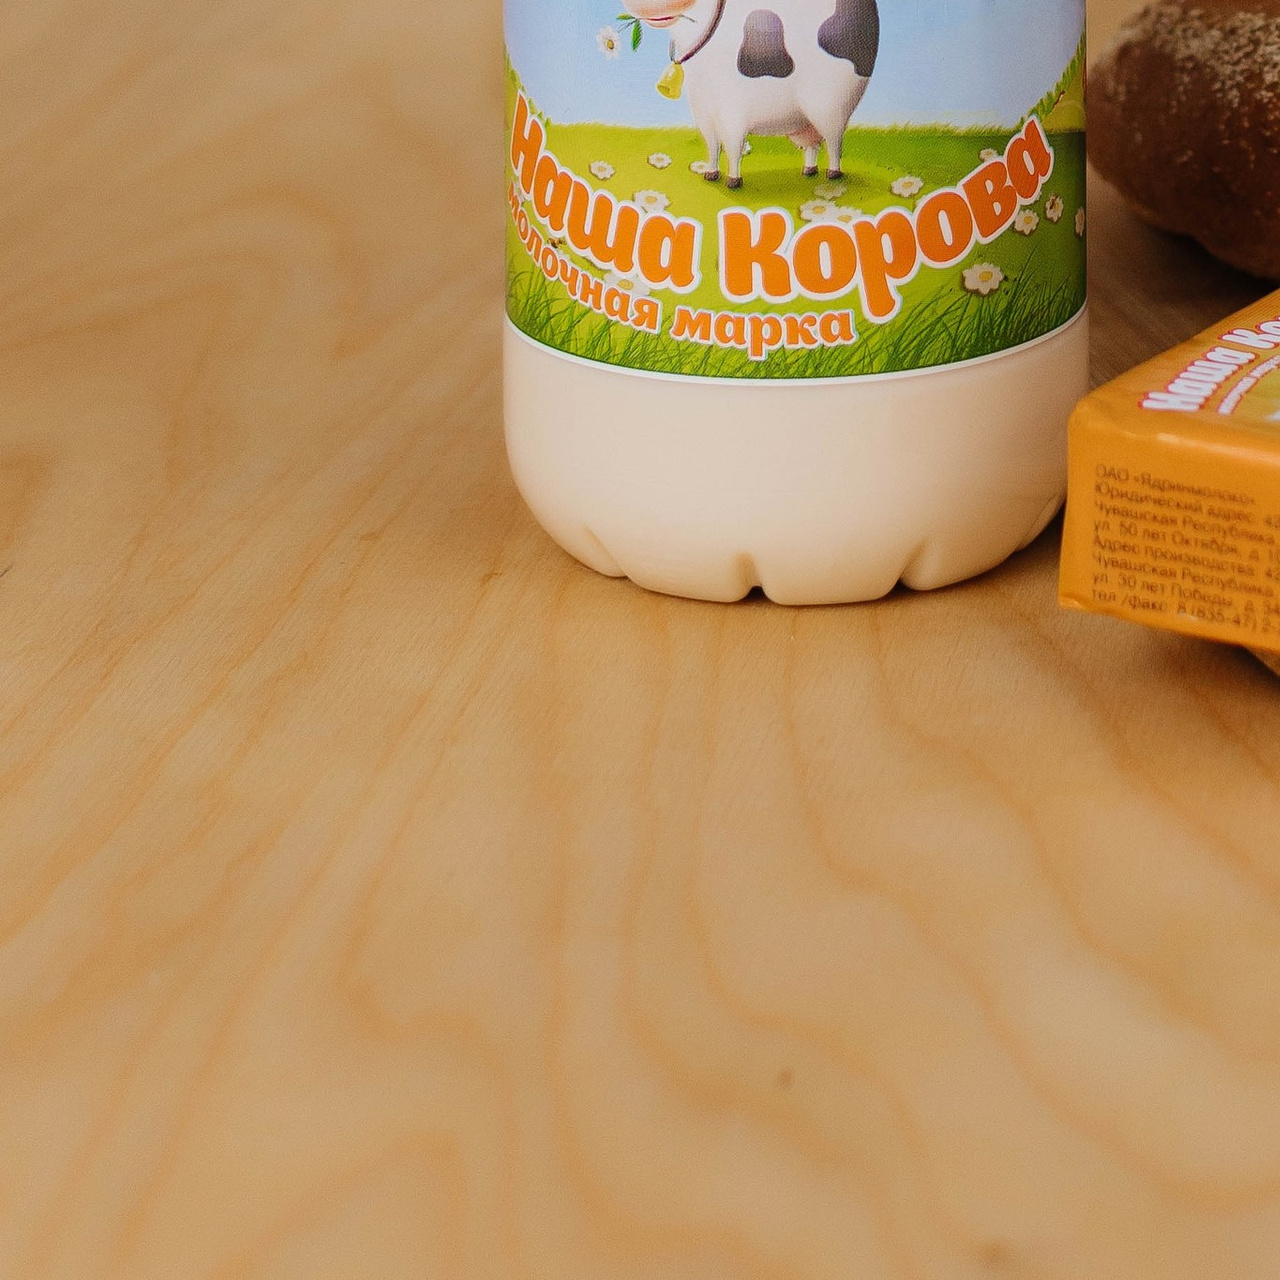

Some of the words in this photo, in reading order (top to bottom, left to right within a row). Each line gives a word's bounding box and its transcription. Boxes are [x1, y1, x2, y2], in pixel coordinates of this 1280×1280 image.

[509, 92, 698, 289] Наша
[721, 119, 1053, 319] Корова
[508, 180, 661, 333] молочная
[671, 306, 855, 358] марка
[1140, 345, 1258, 413] Наша
[1095, 464, 1130, 483] ОАО
